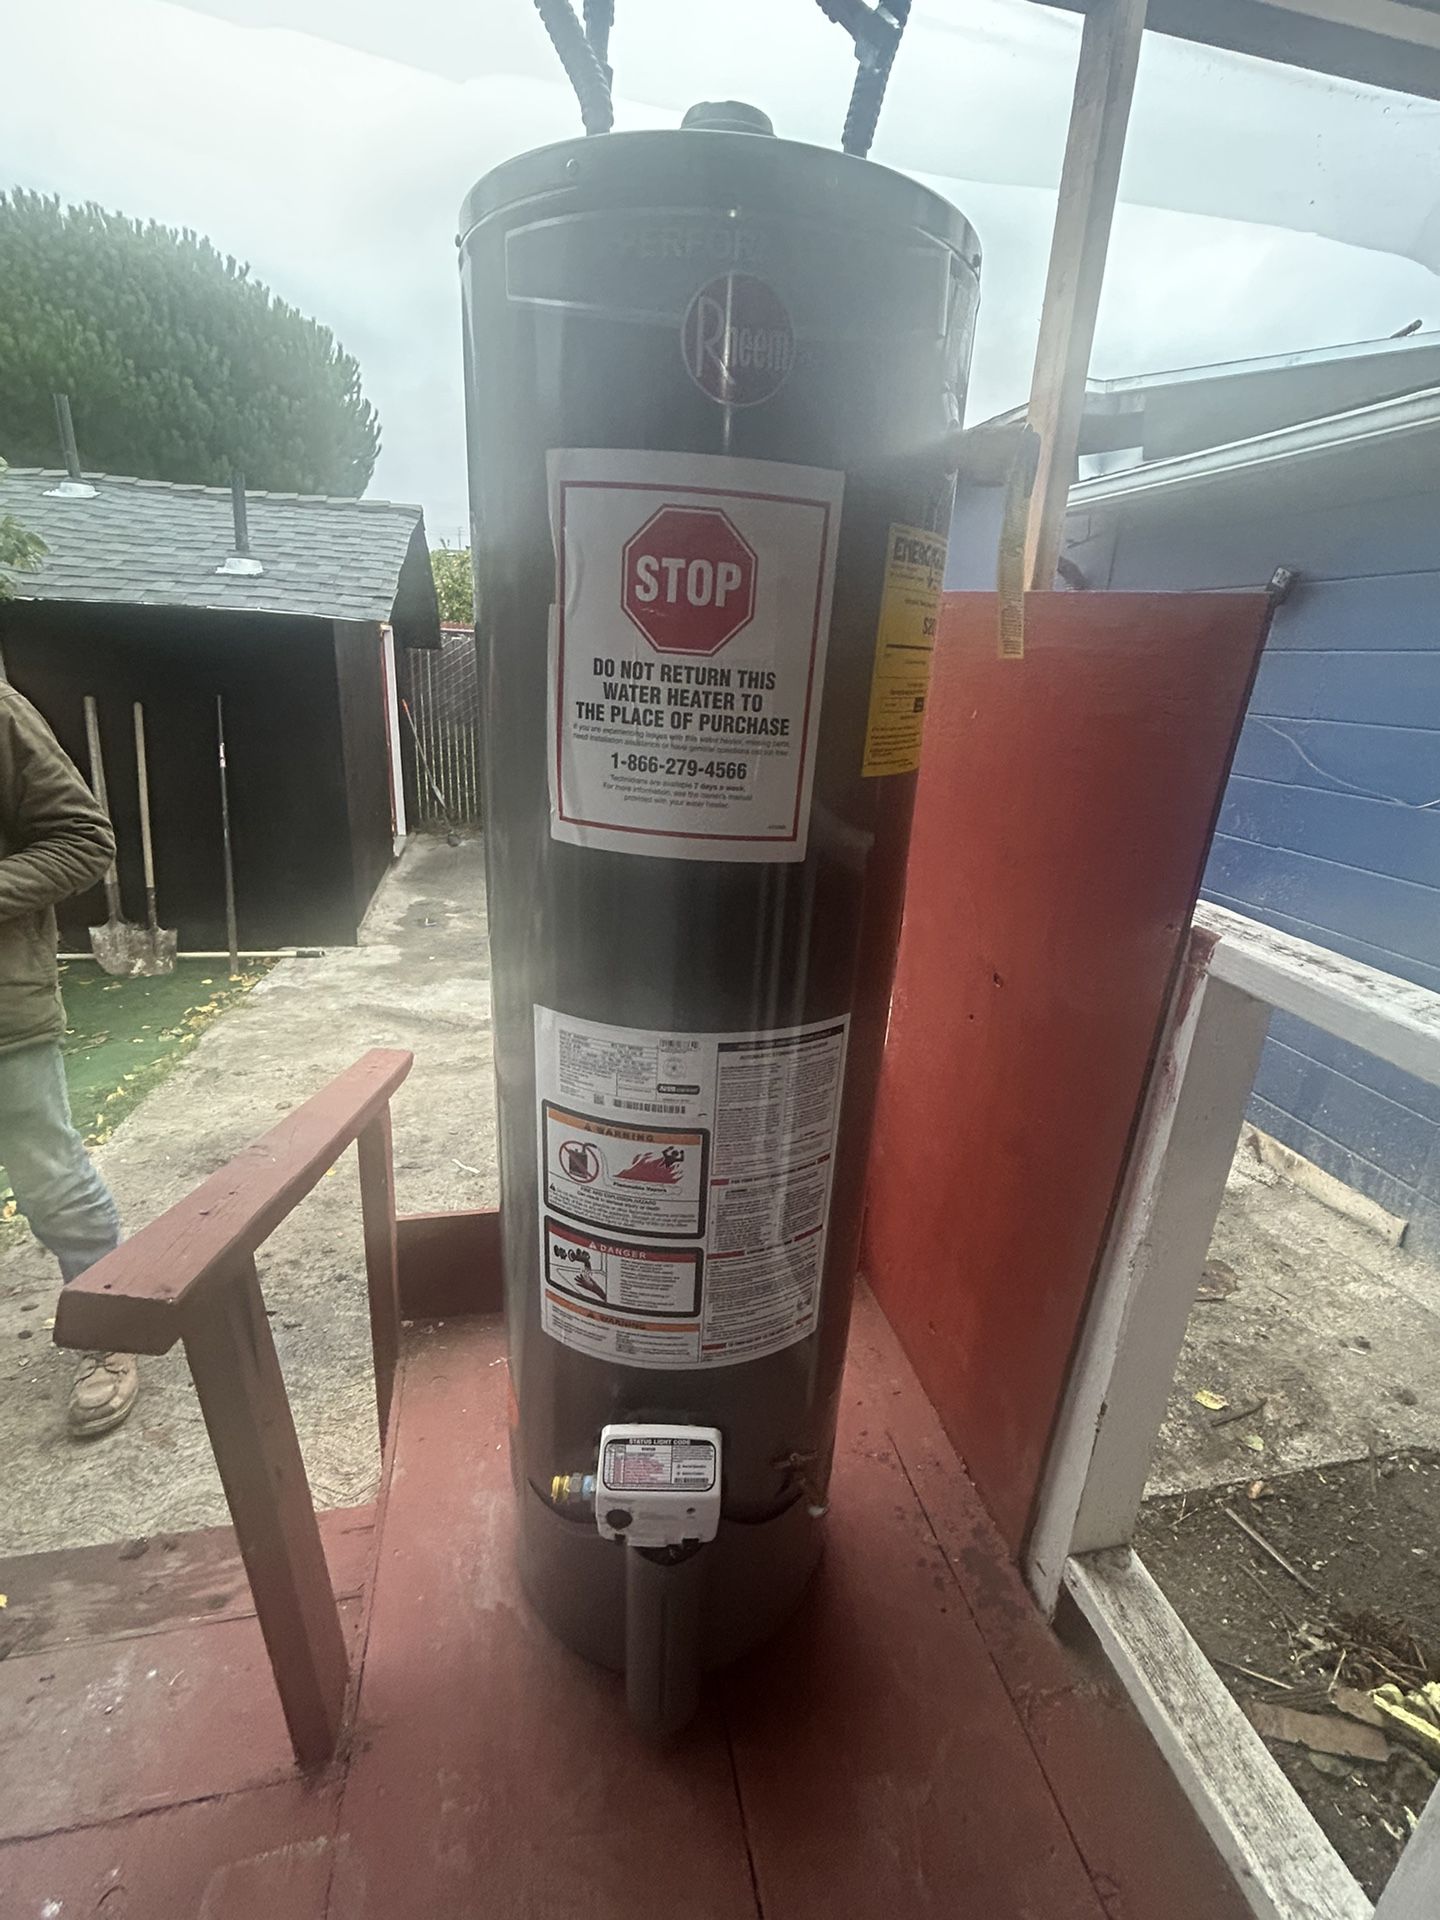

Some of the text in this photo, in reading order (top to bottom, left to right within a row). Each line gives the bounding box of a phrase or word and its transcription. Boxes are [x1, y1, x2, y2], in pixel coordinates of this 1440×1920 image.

[696, 296, 793, 385] Rheem
[635, 555, 742, 607] STOP
[593, 657, 777, 690] DO NOT RETURN THIS
[603, 682, 763, 713] WATER HEATER TO
[576, 701, 790, 737] THE PLACE OF PURCHASE
[611, 752, 747, 780] 1-866-279-4566
[603, 781, 614, 789] For
[700, 783, 717, 791] days
[596, 1126, 656, 1143] WARNING
[600, 1243, 647, 1259] DANGER
